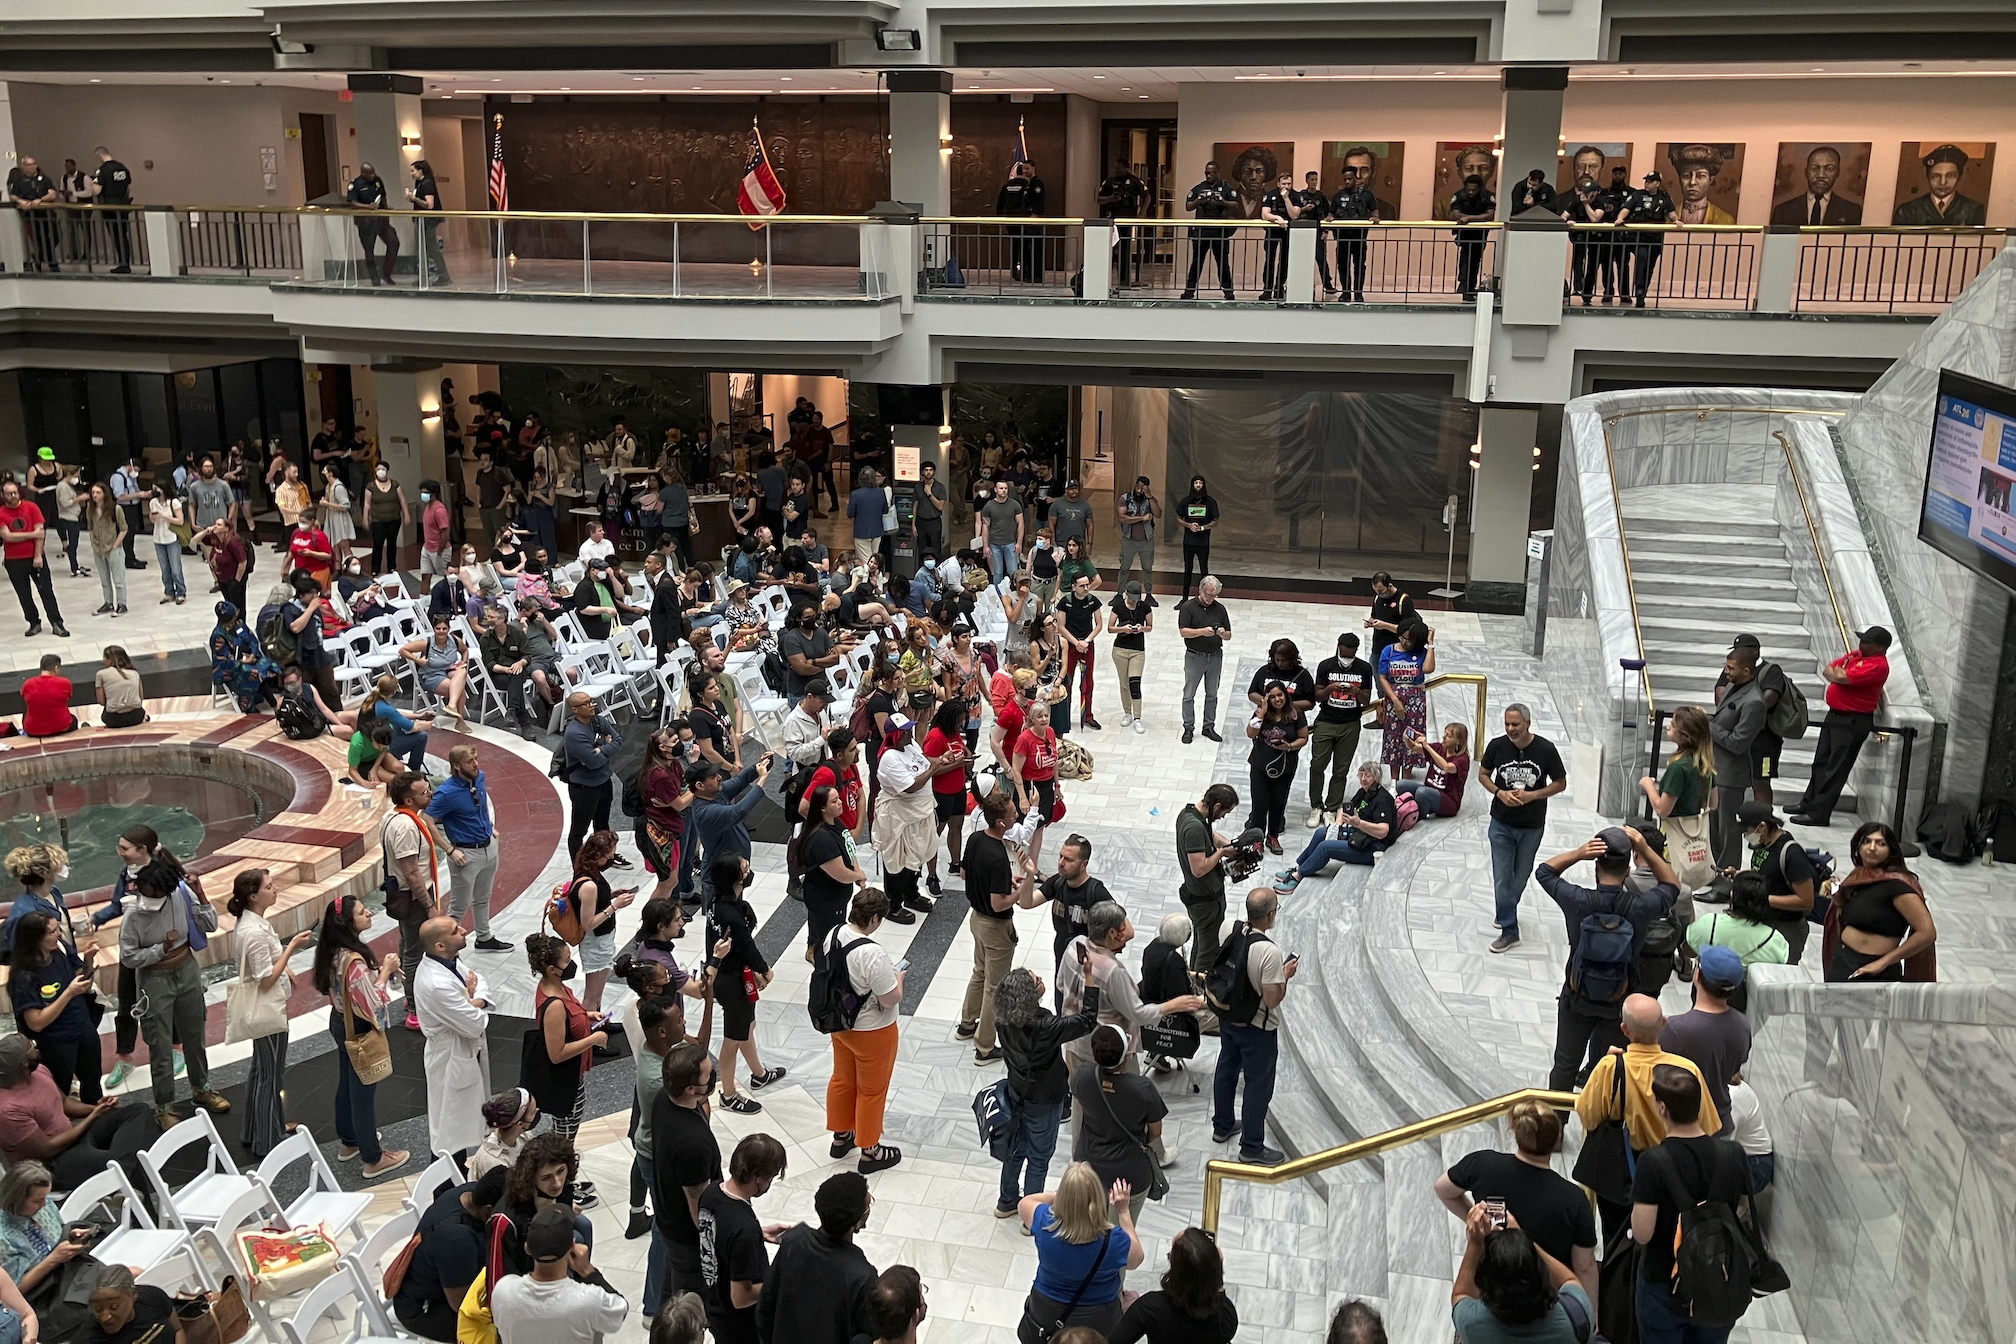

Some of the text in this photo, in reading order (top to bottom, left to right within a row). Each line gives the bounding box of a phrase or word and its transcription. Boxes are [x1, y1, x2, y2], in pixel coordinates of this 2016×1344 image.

[1328, 672, 1362, 683] SOLUTIONS
[1144, 1025, 1189, 1037] GRANDMOTHERS
[1160, 1034, 1172, 1042] FOR
[1155, 1040, 1173, 1048] PEACE
